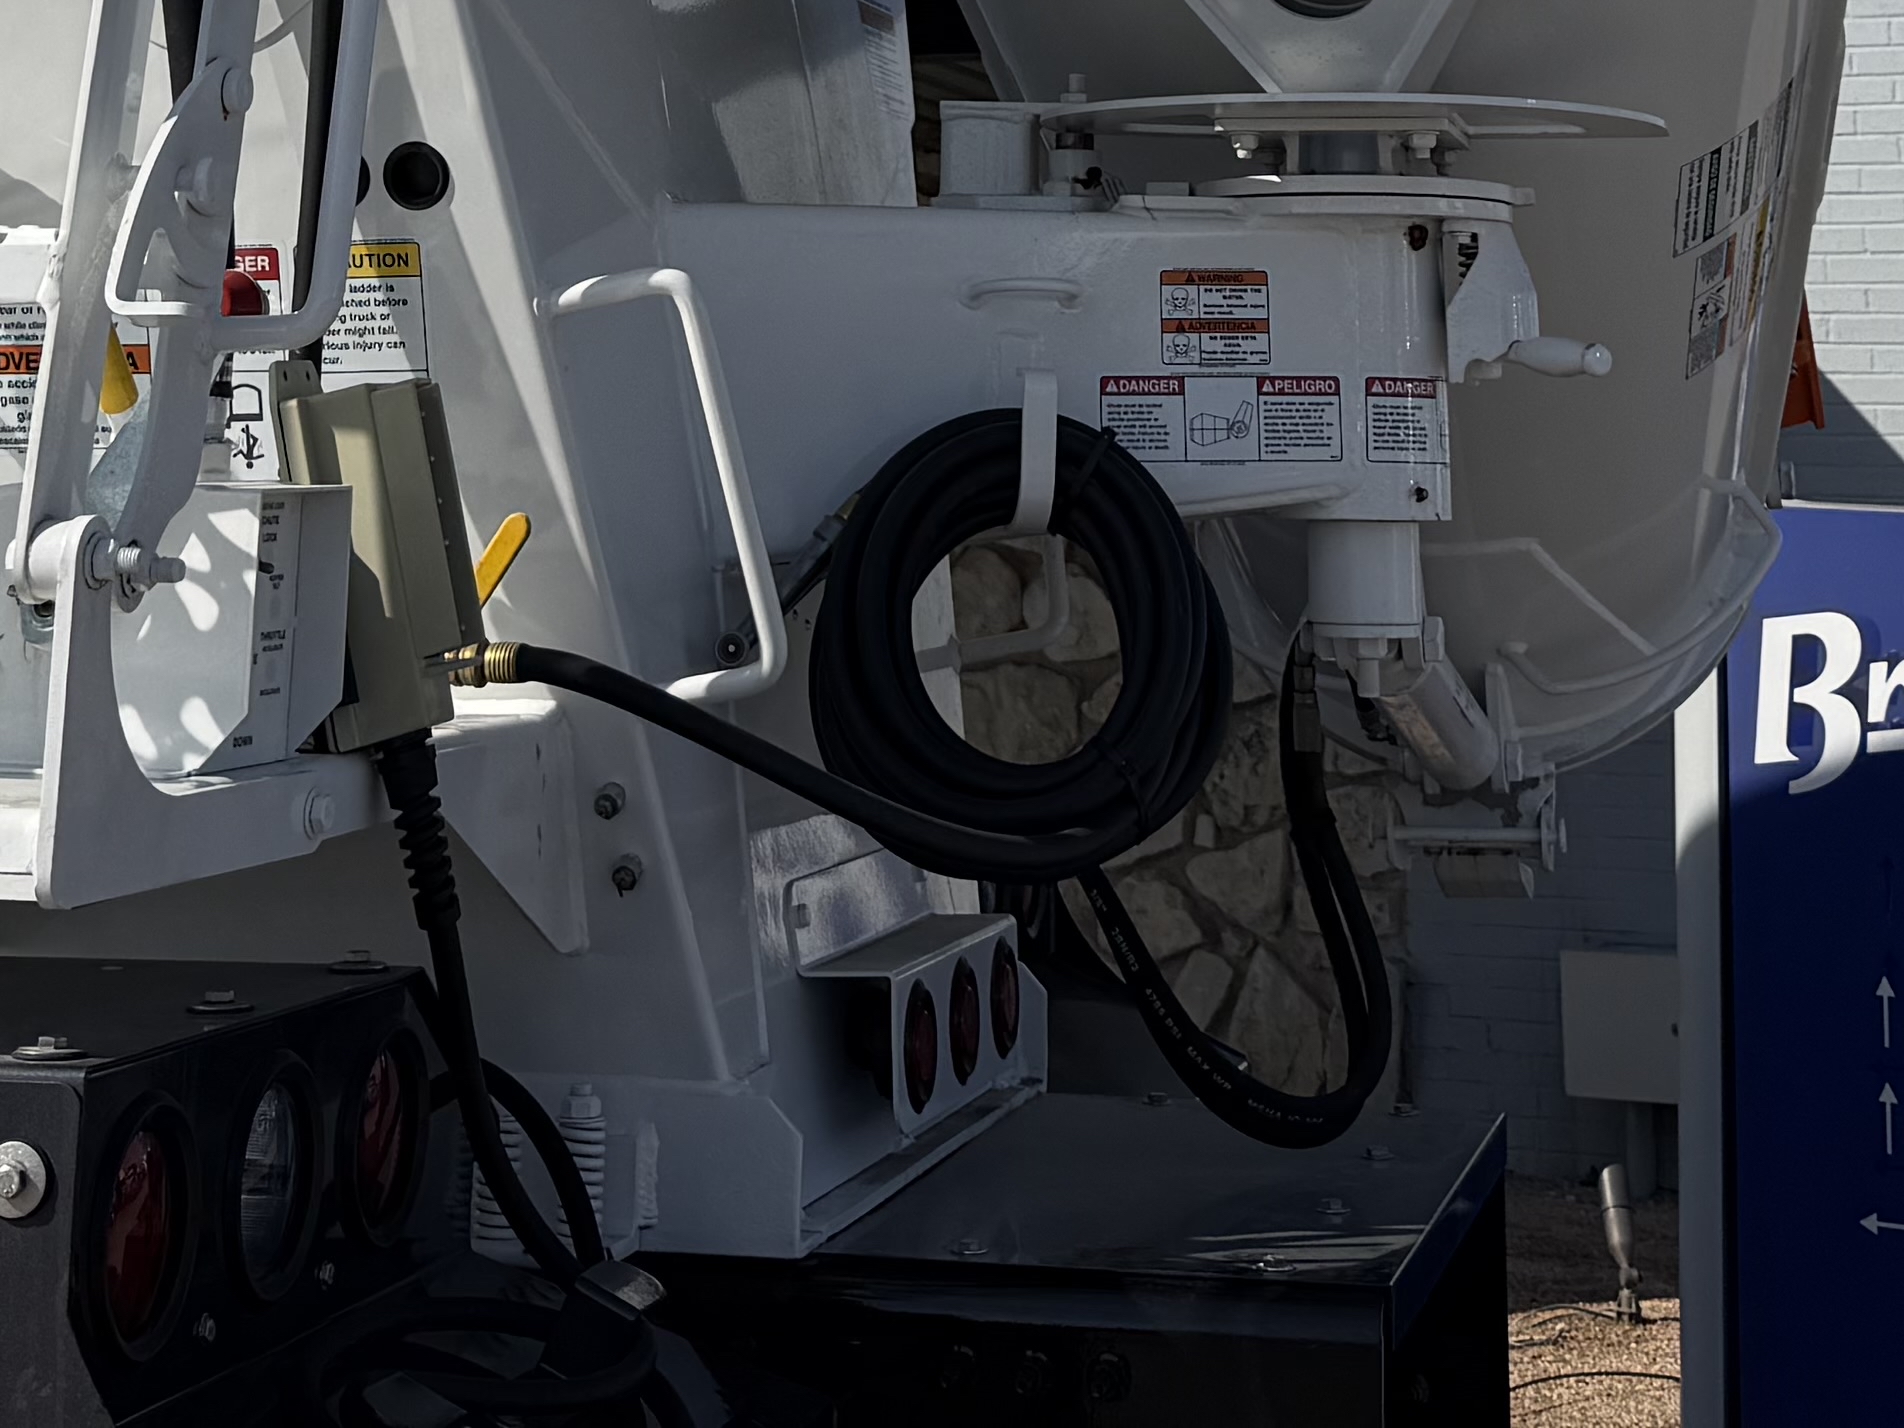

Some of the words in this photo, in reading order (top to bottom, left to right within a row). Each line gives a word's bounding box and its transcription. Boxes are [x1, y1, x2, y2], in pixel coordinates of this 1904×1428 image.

[234, 255, 270, 272] GER
[1197, 274, 1244, 283] WARNING
[349, 282, 383, 293] ladder
[374, 297, 408, 307] before
[349, 311, 376, 322] truck
[344, 325, 375, 338] might
[1188, 322, 1256, 331] ADVERTENCIA
[352, 340, 384, 352] injury
[386, 341, 406, 349] can
[1119, 379, 1179, 393] DANGER
[1275, 379, 1336, 393] PELIGRO
[1384, 380, 1434, 395] DANGER
